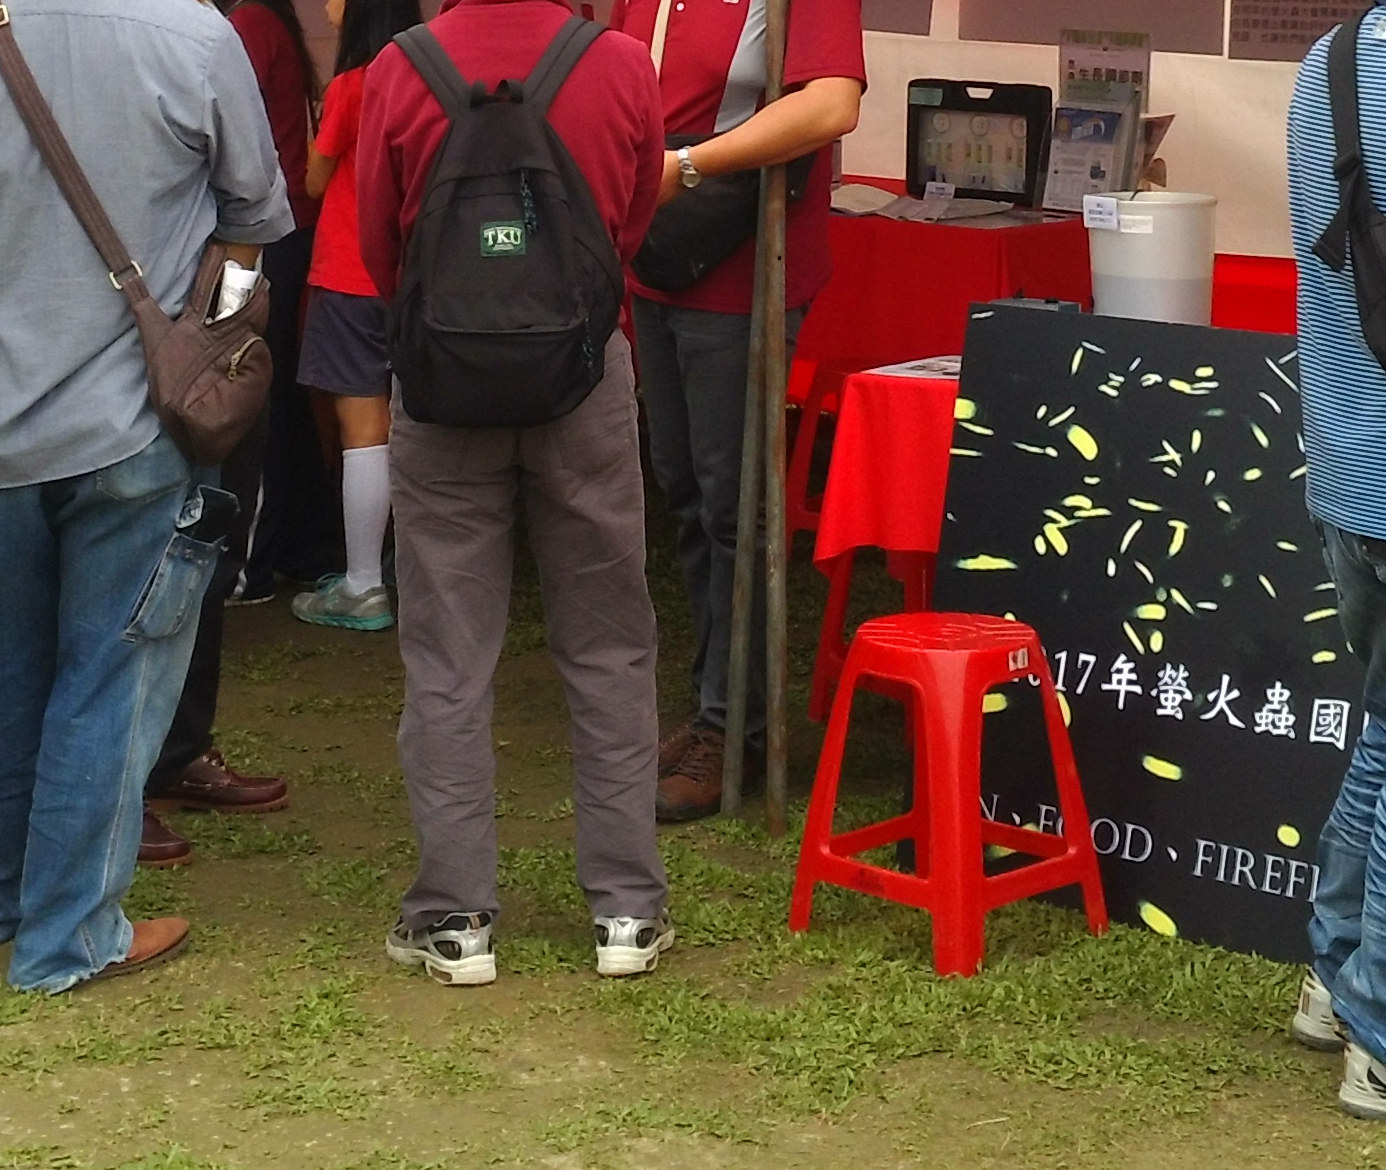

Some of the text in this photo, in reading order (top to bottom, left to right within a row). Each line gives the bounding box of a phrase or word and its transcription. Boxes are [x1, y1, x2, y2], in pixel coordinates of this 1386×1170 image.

[483, 226, 522, 246] TKU
[1013, 645, 1370, 750] 17年螢火蟲國
